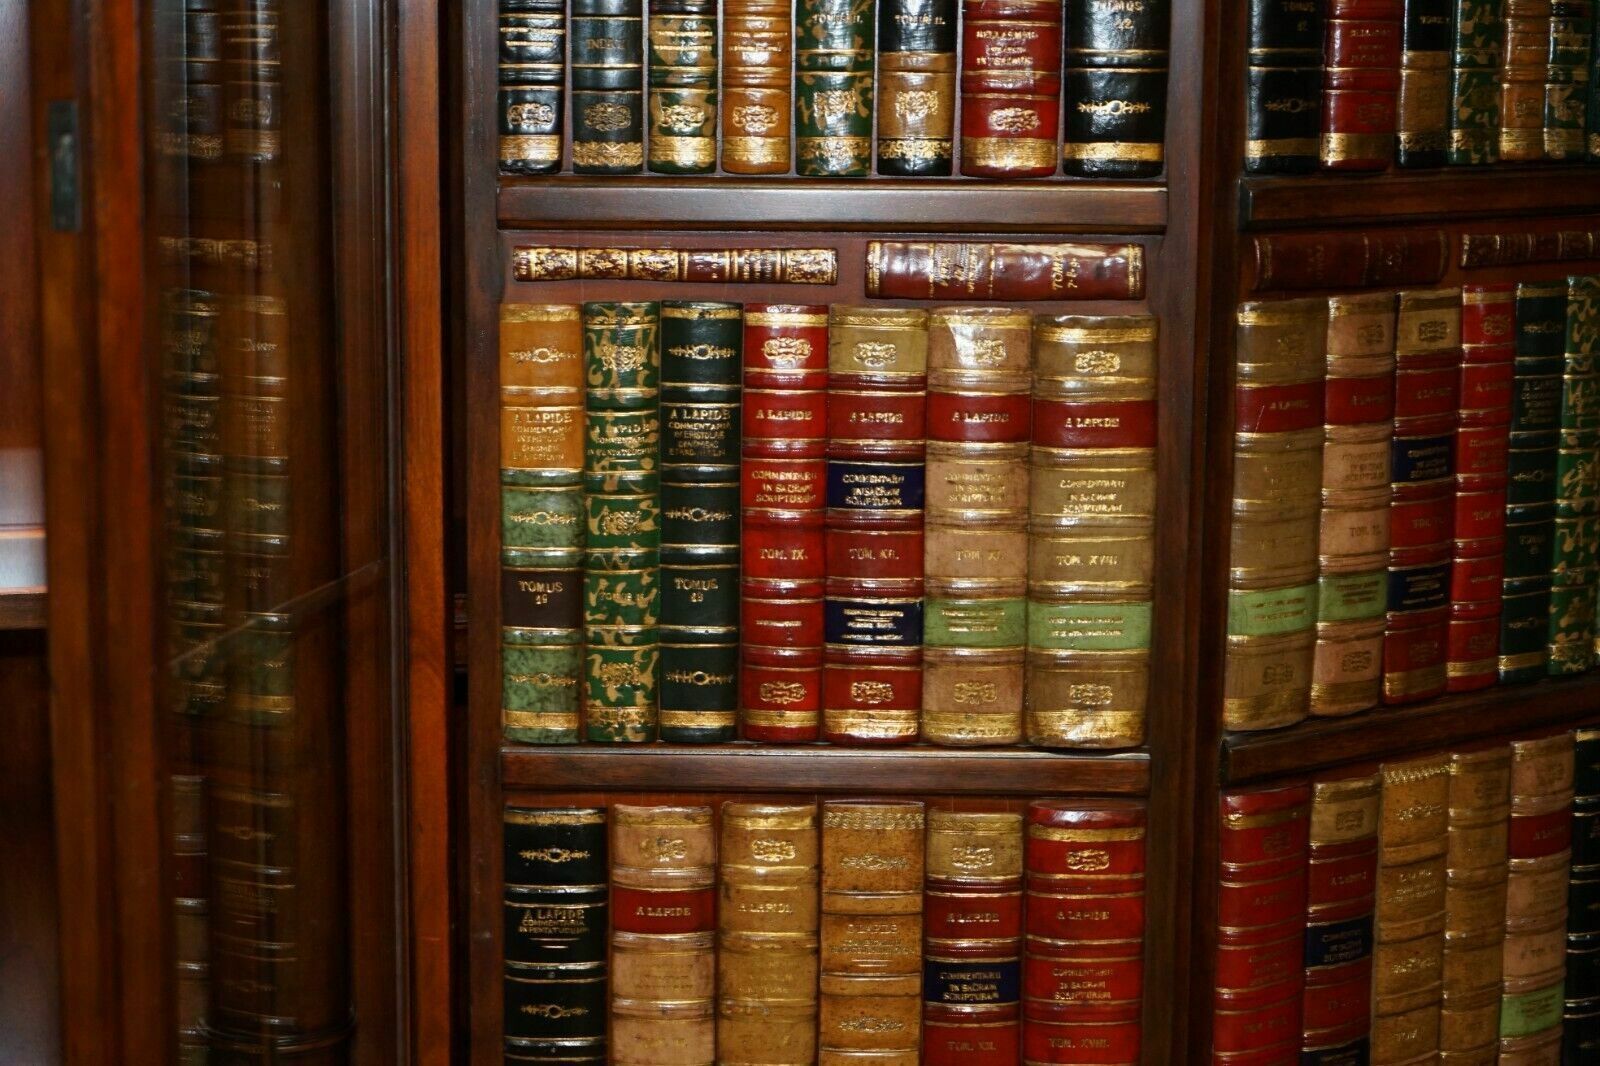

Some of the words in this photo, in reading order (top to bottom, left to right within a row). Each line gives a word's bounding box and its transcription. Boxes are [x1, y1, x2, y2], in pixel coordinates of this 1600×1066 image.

[525, 411, 573, 424] LAPIDE
[682, 408, 732, 421] LAPIDE
[755, 409, 764, 420] A
[766, 409, 813, 421] LAPIDE
[860, 412, 904, 424] LAPIDE
[964, 412, 1009, 423] LAPIDE
[1076, 417, 1121, 429] LAPIDE
[762, 483, 772, 492] IN
[517, 580, 564, 594] TOMUS
[674, 577, 719, 591] TOMUS
[537, 909, 585, 920] LAPIDE
[636, 906, 644, 916] A
[647, 907, 691, 917] LAPIDE
[958, 912, 1000, 923] LAPIDE
[1068, 910, 1111, 922] LAPIDE
